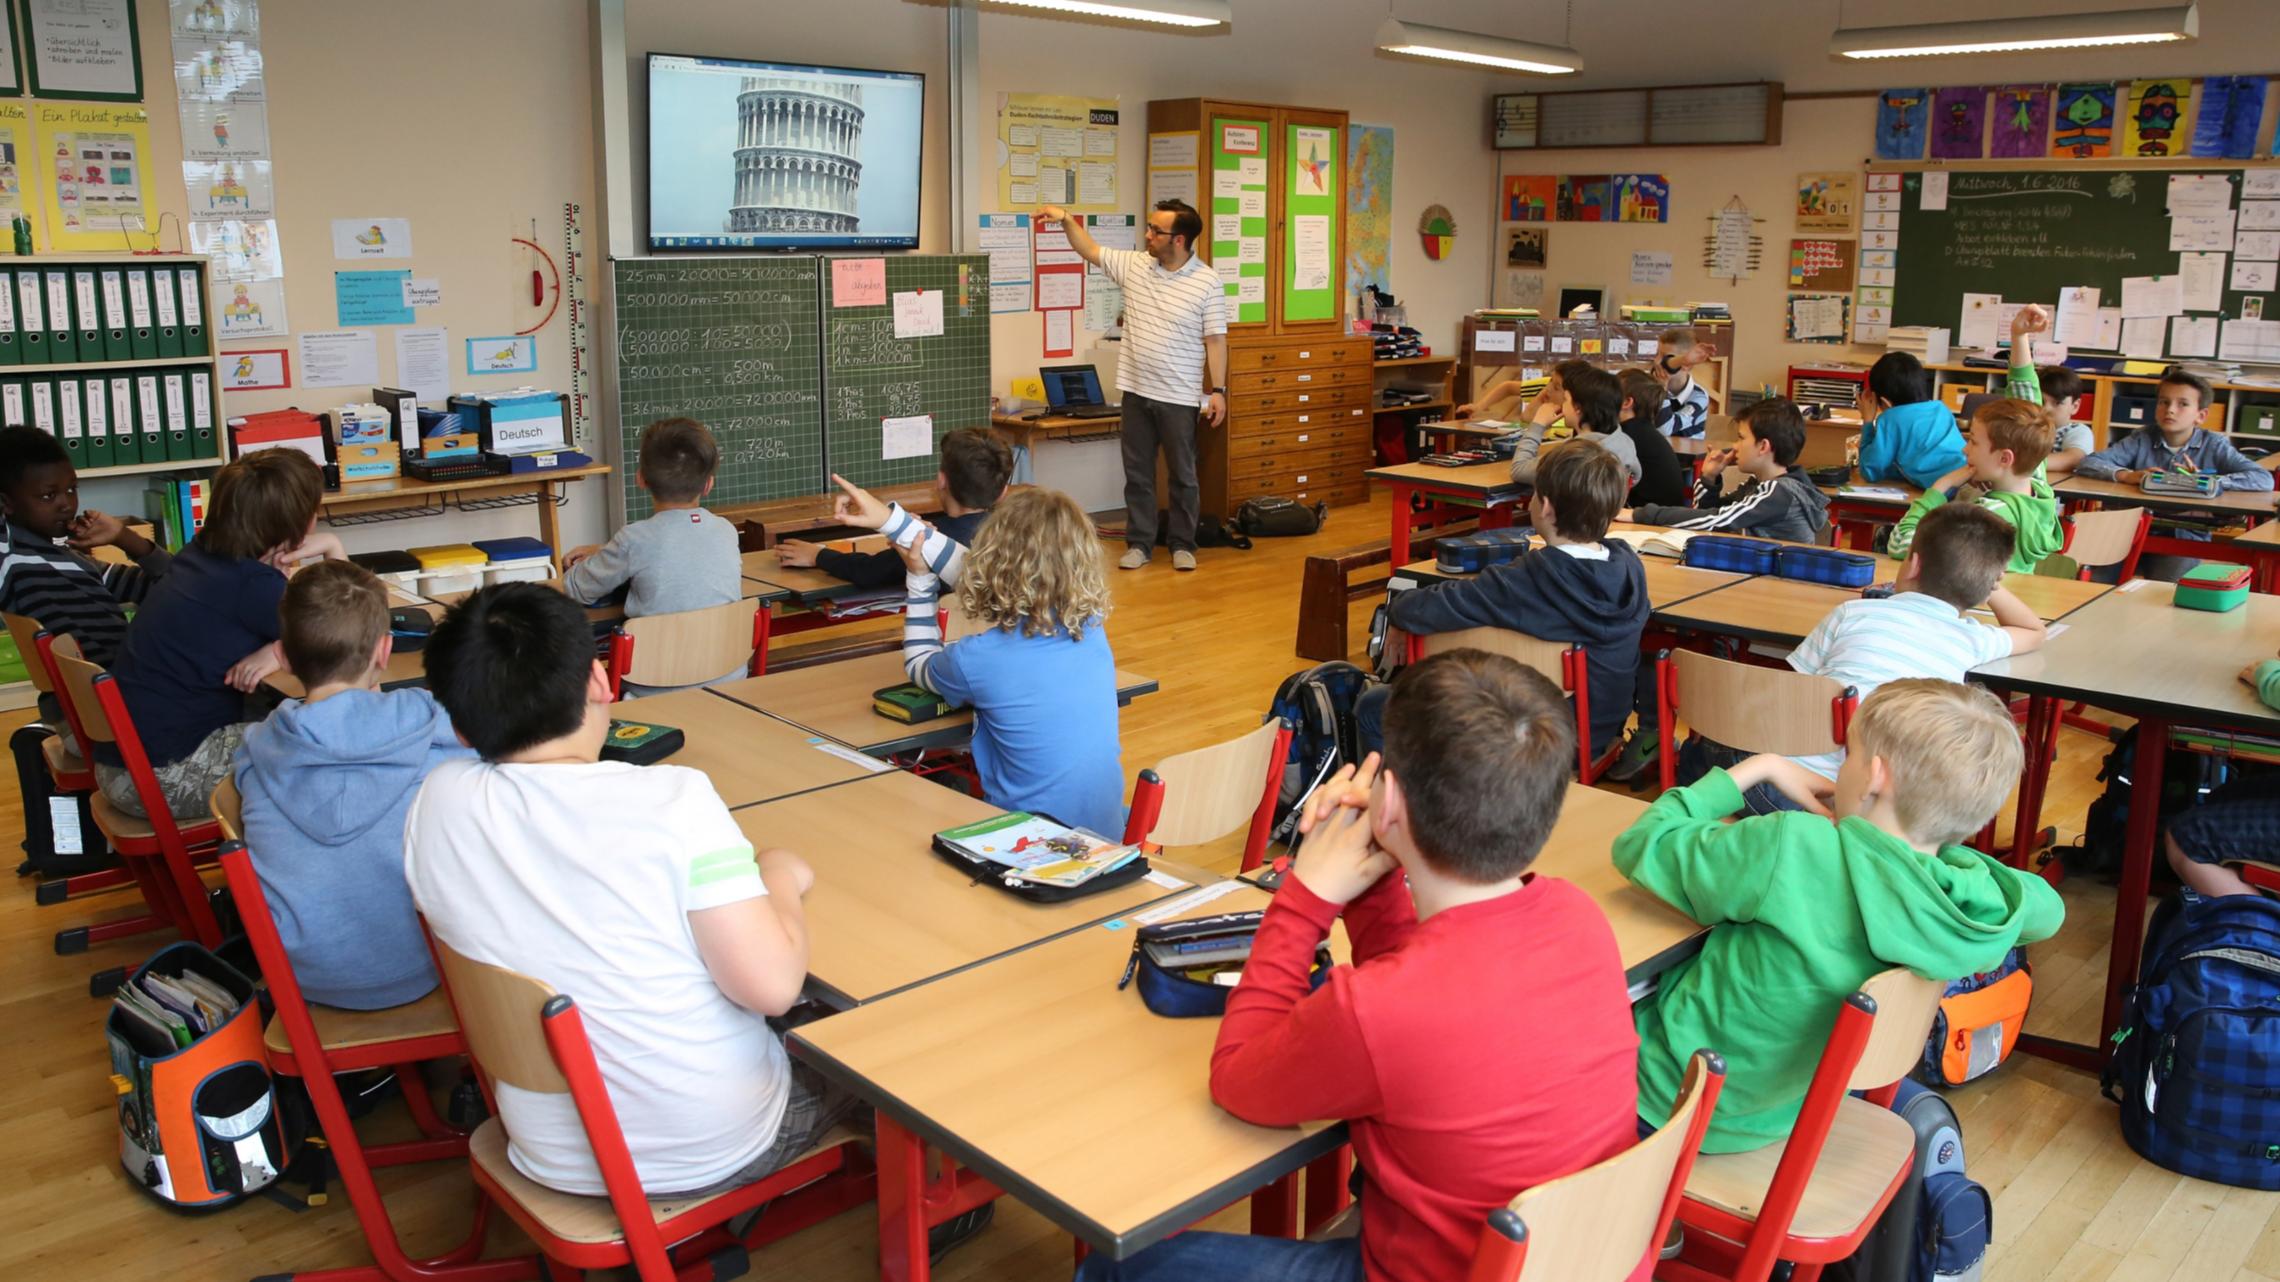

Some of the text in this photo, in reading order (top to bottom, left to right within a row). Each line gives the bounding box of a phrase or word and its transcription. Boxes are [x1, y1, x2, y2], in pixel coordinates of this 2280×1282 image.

[85, 47, 98, 55] und
[75, 56, 116, 65] aufkleben
[42, 109, 148, 127] Ein Plakat gestalten
[1090, 113, 1115, 123] DUDEN
[1953, 175, 2016, 192] Mittwoch,
[572, 204, 580, 214] 10
[577, 299, 584, 307] 6
[578, 322, 585, 330] 5
[579, 346, 586, 354] 4
[237, 379, 259, 387] Mathe
[499, 426, 543, 441] Deutsch
